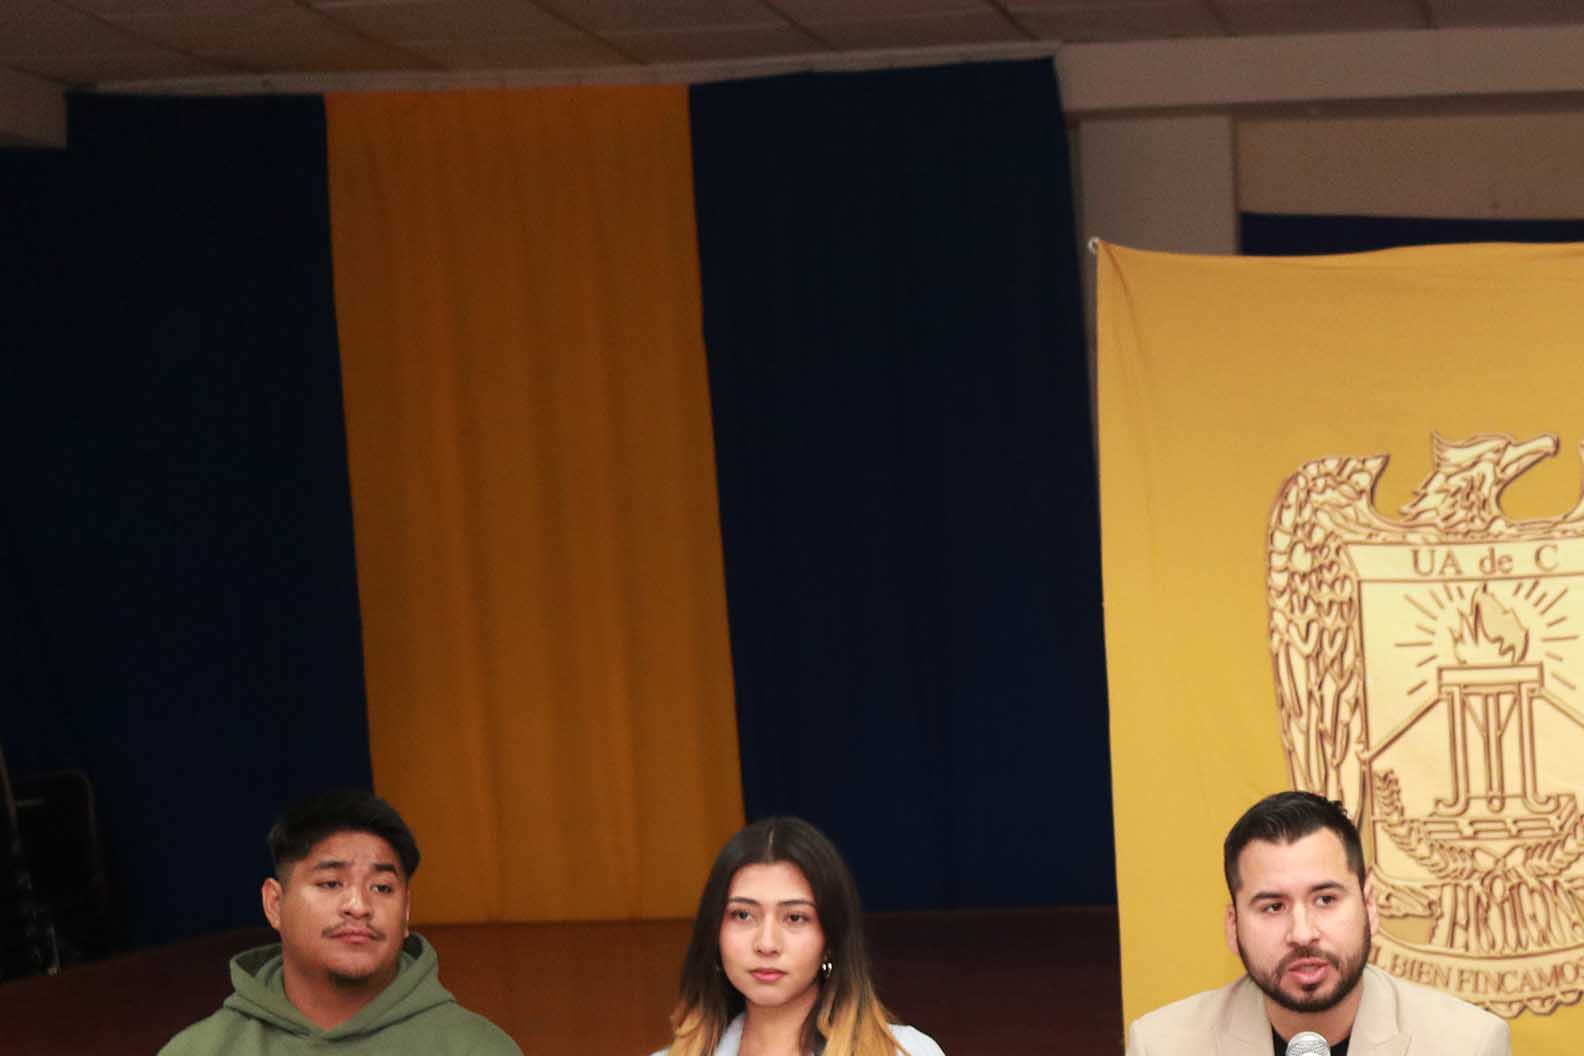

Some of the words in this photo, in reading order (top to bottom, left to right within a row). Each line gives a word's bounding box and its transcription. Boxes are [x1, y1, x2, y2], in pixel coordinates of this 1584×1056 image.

[1411, 548, 1463, 577] UA
[1479, 546, 1514, 575] de
[1534, 543, 1559, 573] C
[1390, 953, 1451, 988] BIEN
